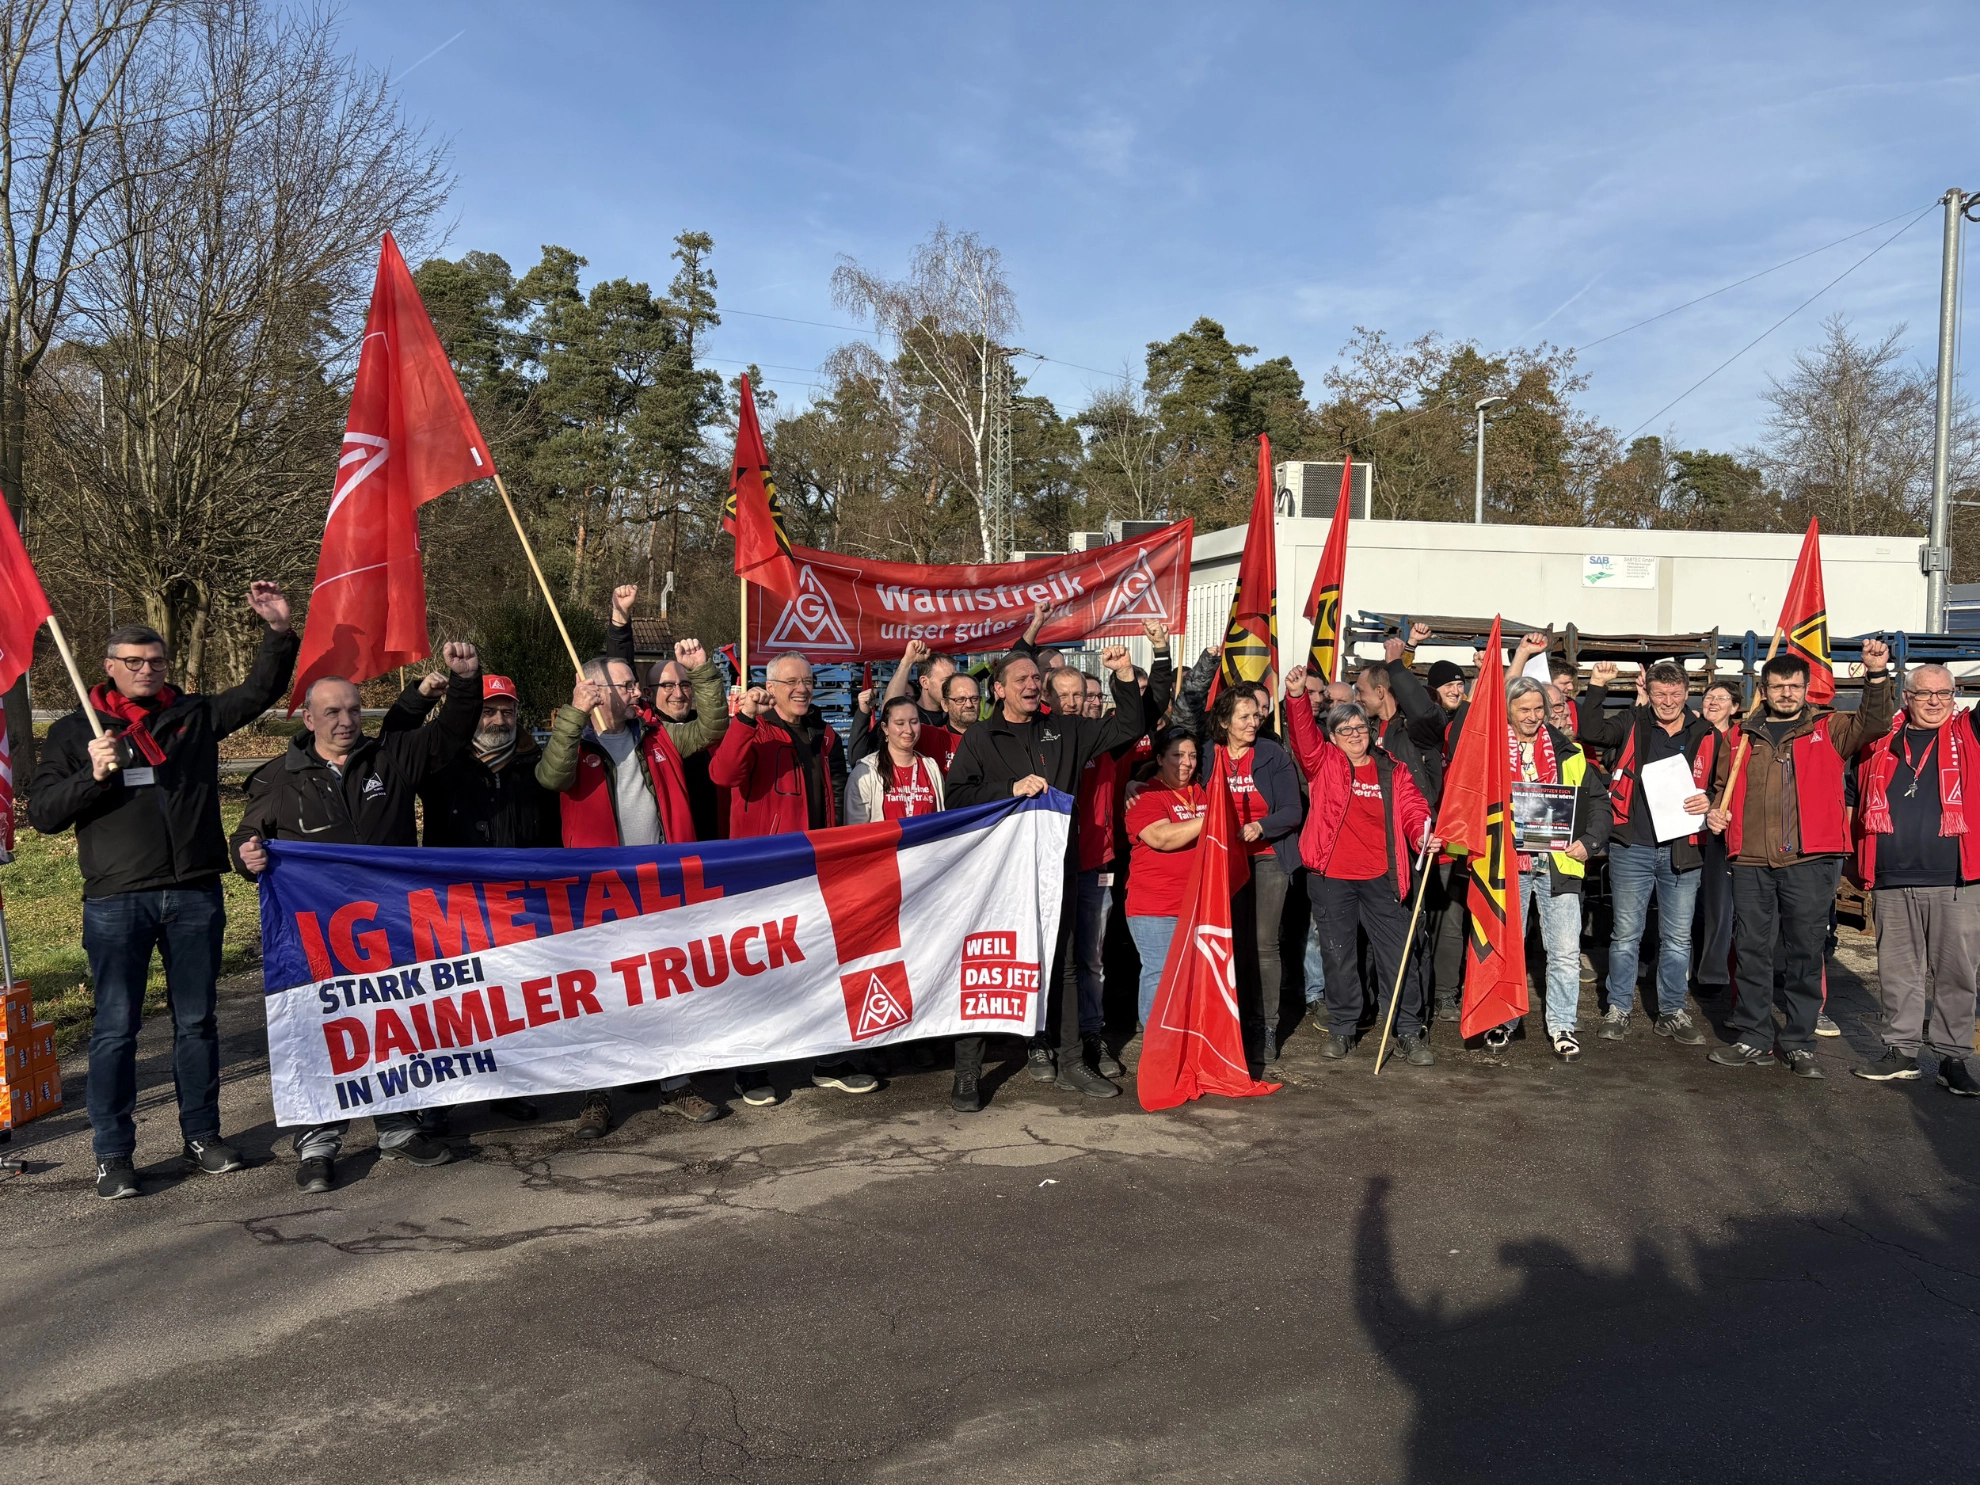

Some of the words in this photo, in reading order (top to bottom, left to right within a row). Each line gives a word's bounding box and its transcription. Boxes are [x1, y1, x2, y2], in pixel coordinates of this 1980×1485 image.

[1589, 556, 1609, 564] SAB
[876, 571, 1085, 613] Warnstreik
[880, 622, 949, 640] unser
[295, 900, 393, 983] IG
[407, 855, 724, 963] METALL
[966, 937, 1011, 957] WEIL
[319, 968, 426, 1014] STARK
[430, 957, 485, 991] BEI
[965, 967, 1003, 986] DAS
[1006, 969, 1040, 989] JETZ
[322, 969, 604, 1076] DAIMLER
[611, 914, 806, 1007] TRUCK
[965, 993, 1023, 1016] ZÄHLT.
[335, 1076, 374, 1110] IN
[377, 1049, 498, 1098] WÖRTH
